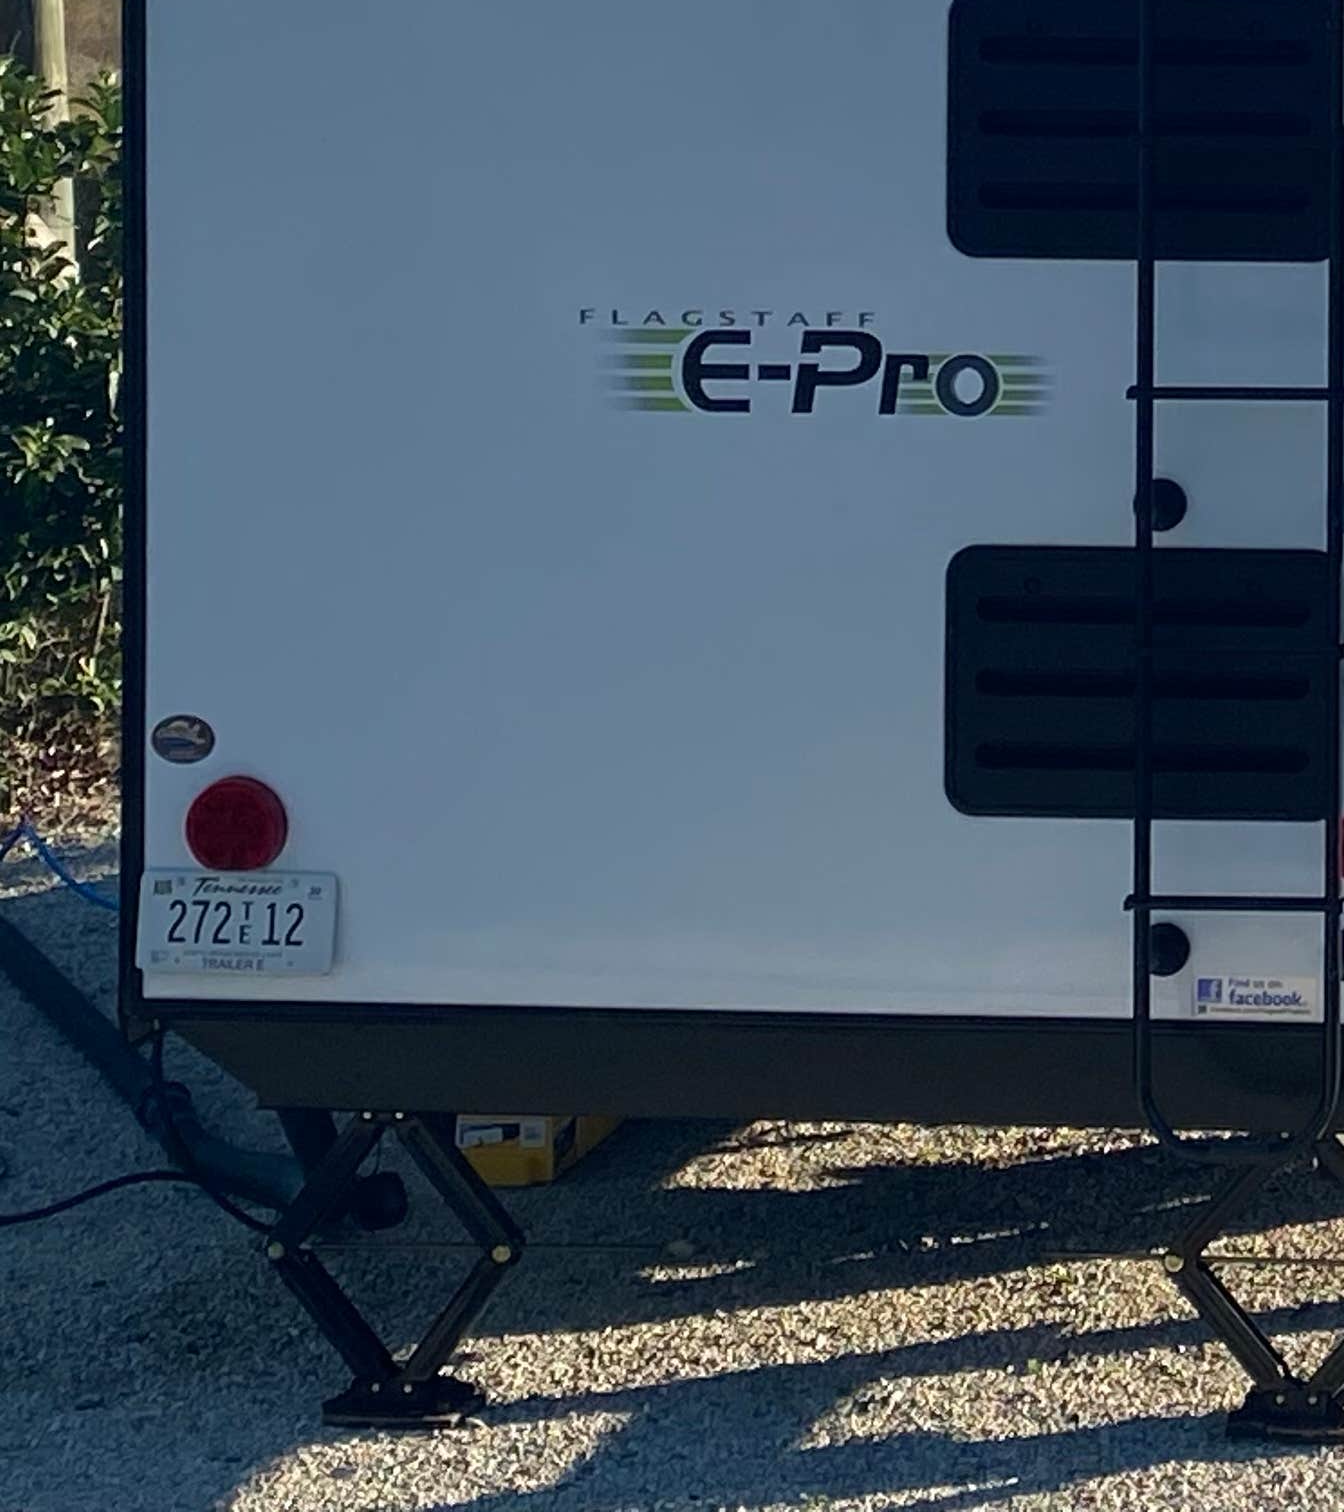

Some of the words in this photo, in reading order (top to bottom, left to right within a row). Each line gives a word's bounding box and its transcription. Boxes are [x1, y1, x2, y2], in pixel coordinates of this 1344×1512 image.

[579, 308, 877, 328] FLAGSTAFF
[681, 329, 1002, 417] E-Pro
[192, 876, 284, 896] Tennessee
[167, 899, 232, 944] 272
[261, 902, 305, 946] 12
[1229, 988, 1302, 1006] facebook
